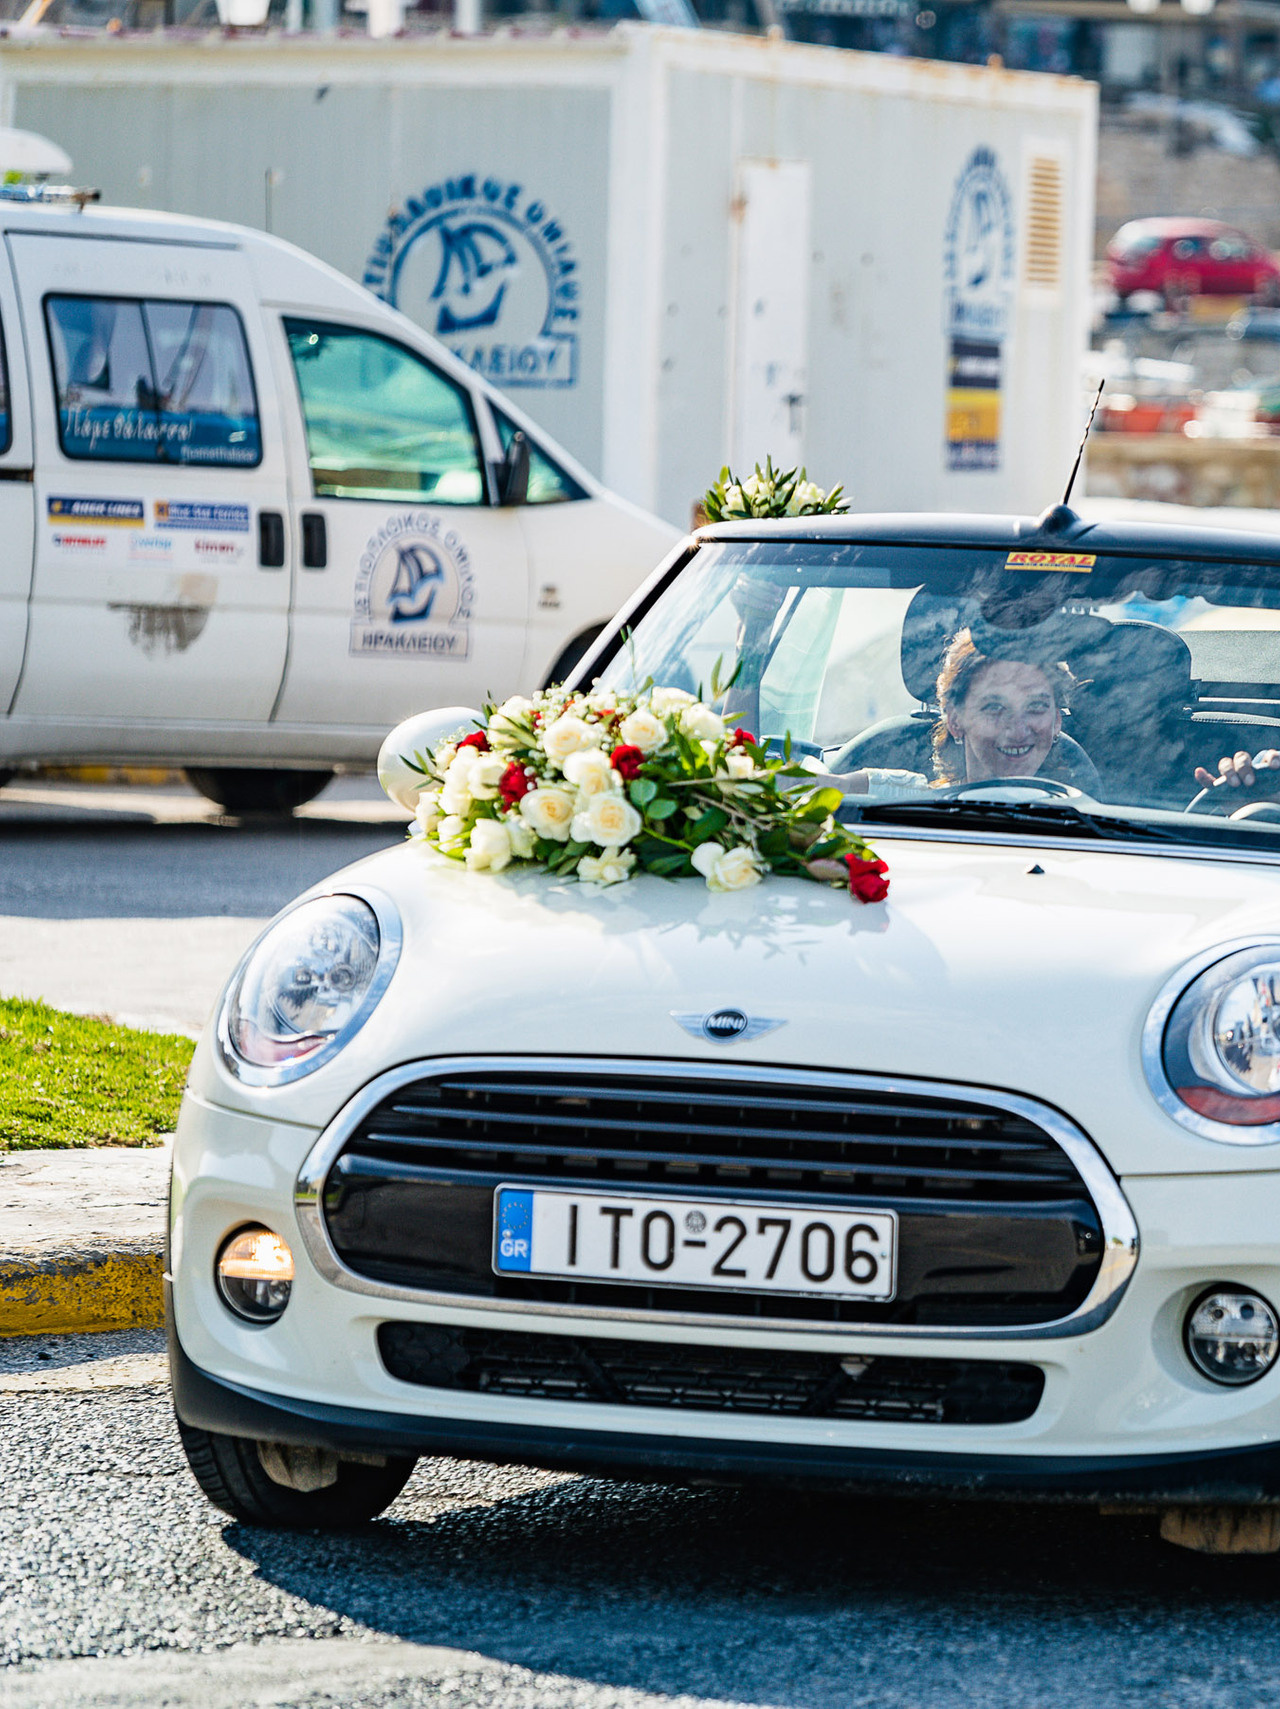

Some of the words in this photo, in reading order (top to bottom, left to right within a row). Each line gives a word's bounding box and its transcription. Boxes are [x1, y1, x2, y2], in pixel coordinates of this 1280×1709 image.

[1010, 554, 1093, 565] ROYAL
[707, 1015, 744, 1030] MINI
[501, 1238, 528, 1258] GR
